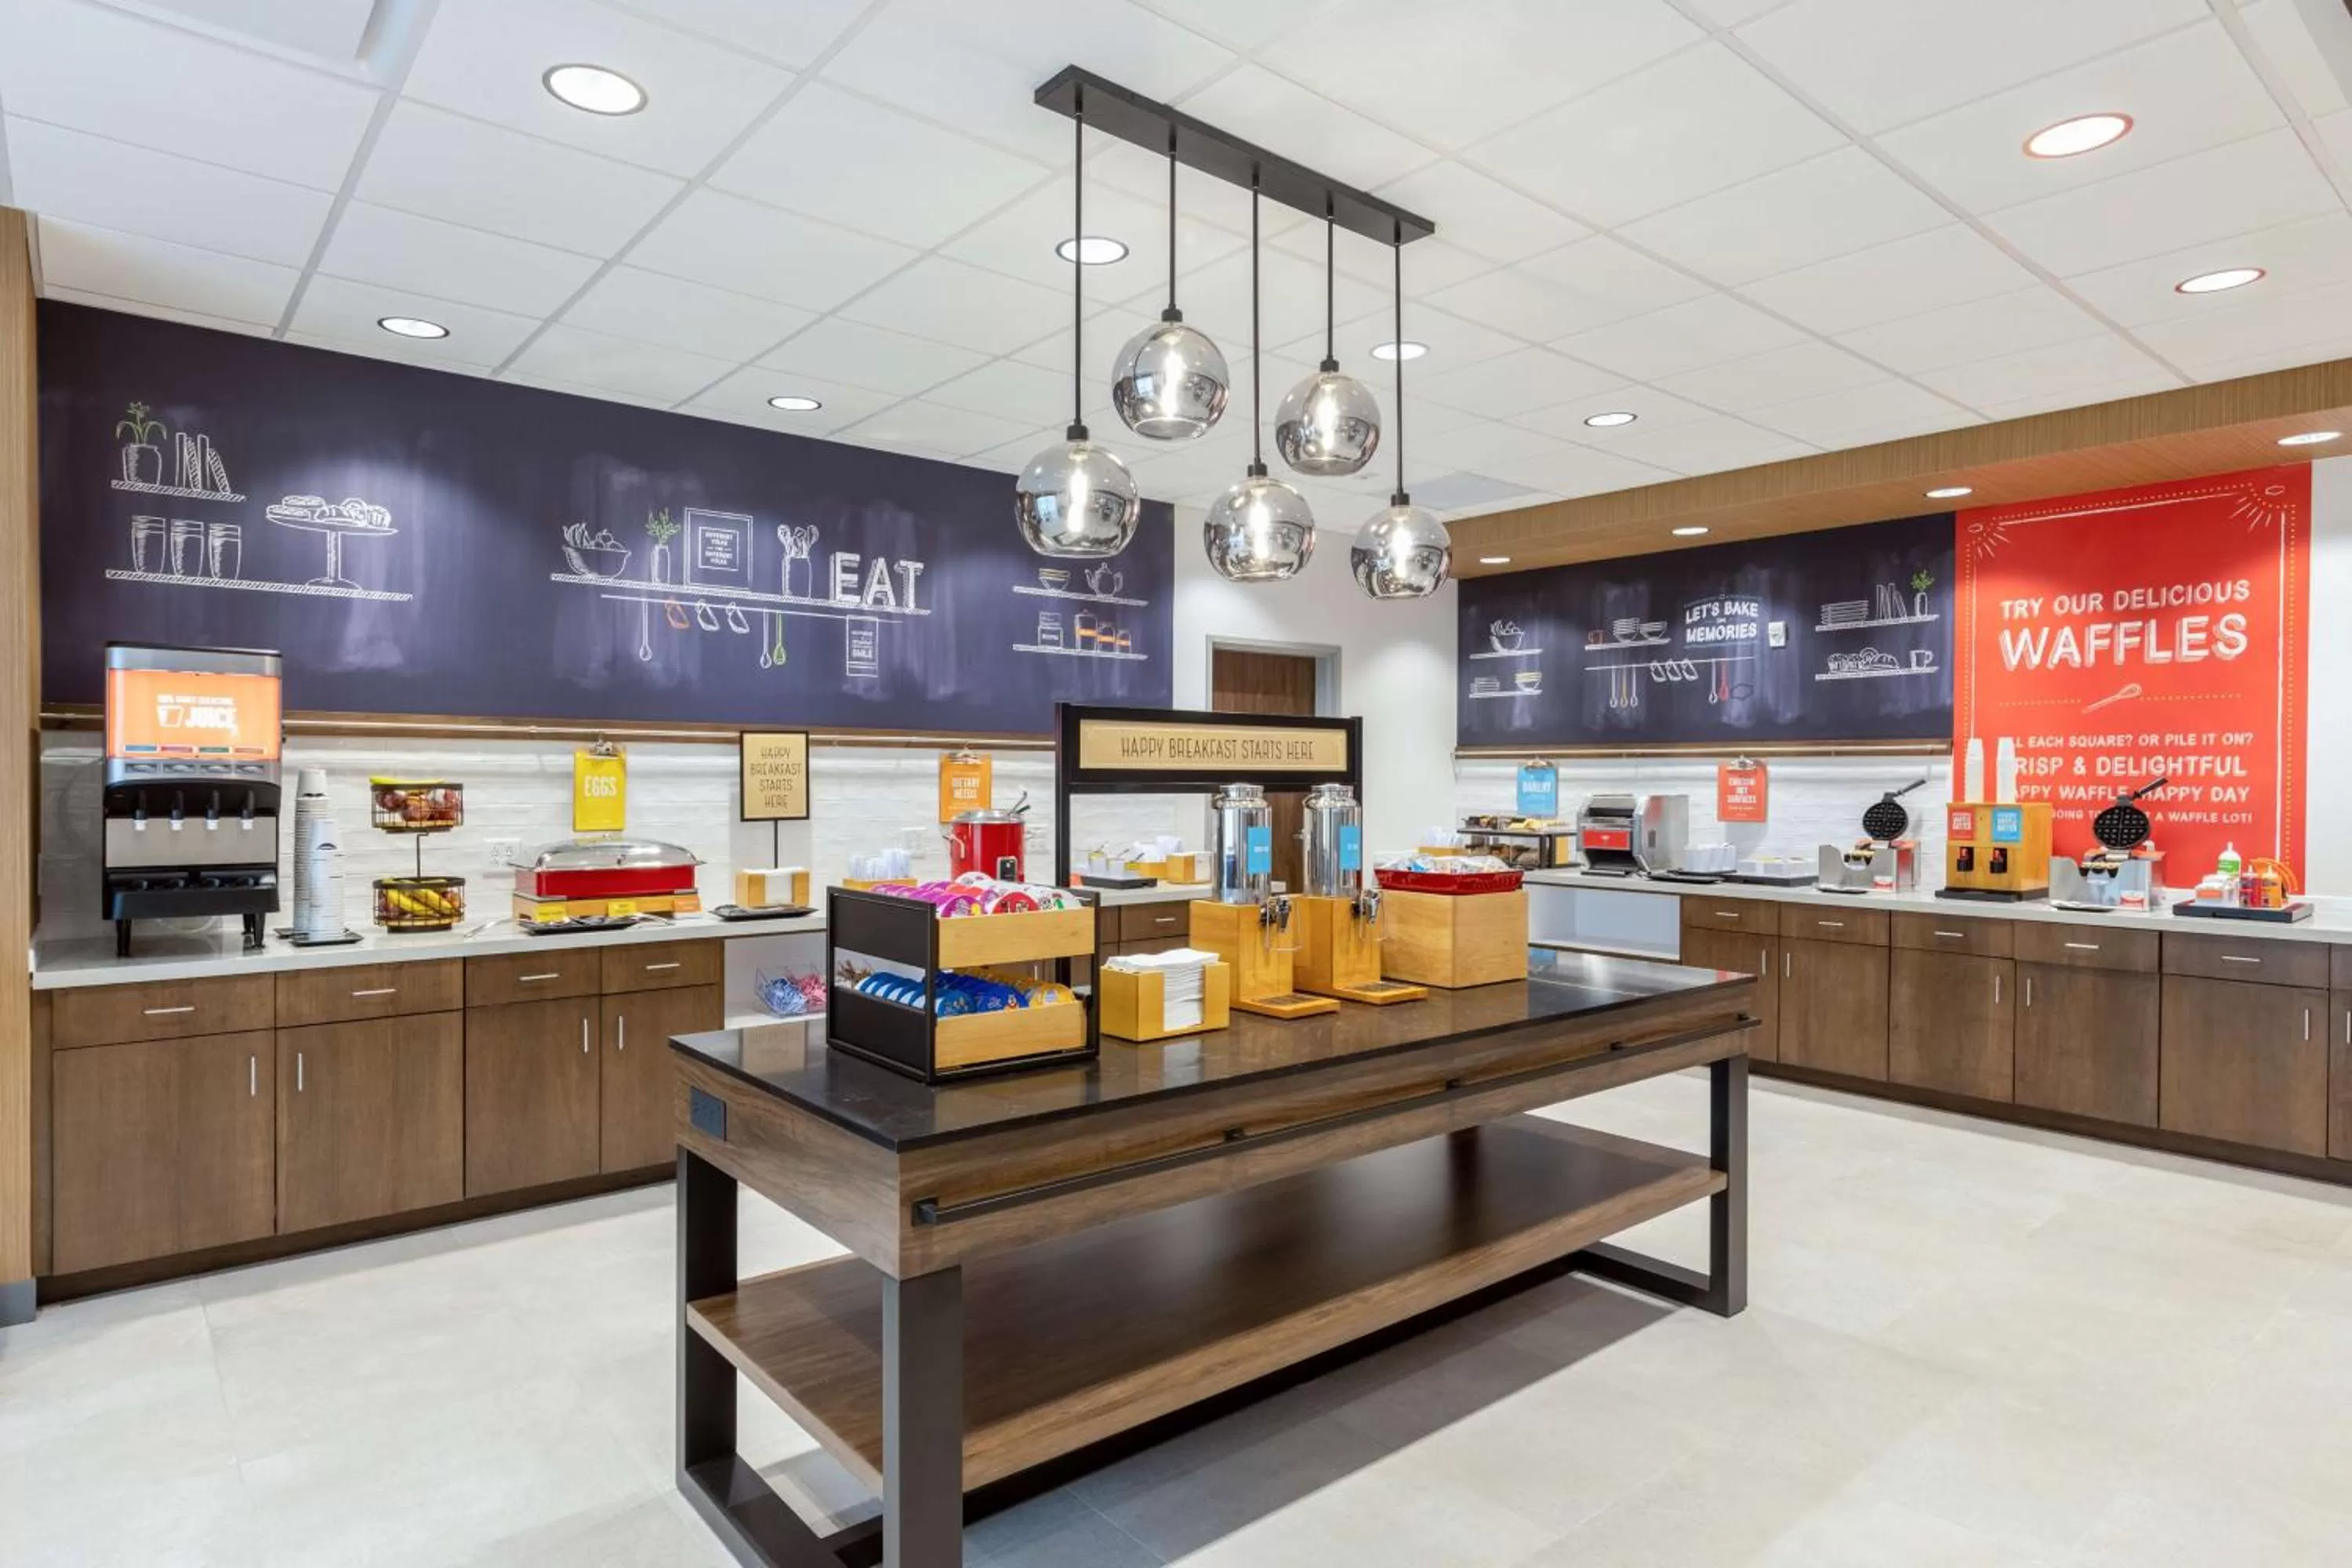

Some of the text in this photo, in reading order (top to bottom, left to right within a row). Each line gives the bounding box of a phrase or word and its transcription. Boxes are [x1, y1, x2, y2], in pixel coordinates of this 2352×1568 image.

[829, 551, 925, 609] EAT
[2000, 579, 2251, 619] TRY OUR DELICIOUS
[1685, 601, 1759, 625] LET'S BAKE
[1686, 622, 1758, 644] MEMORIES
[1998, 612, 2249, 672] WAFFLES
[1120, 736, 1315, 760] HAPPY BREAKFAST STARTS HERE
[2028, 735, 2064, 748] EACH
[2068, 733, 2133, 748] SQUARE?
[2138, 734, 2160, 746] OR
[2165, 733, 2197, 746] PILE
[2201, 733, 2217, 746] IT
[2222, 732, 2254, 746] ON?
[760, 746, 791, 760] HAPPY
[750, 761, 802, 777] BREAKFAST
[2015, 755, 2248, 777] RISP & DELIGHTFUL
[584, 775, 618, 797] EGGS
[759, 778, 793, 793] STARTS
[2209, 786, 2250, 804] DAY
[764, 793, 789, 809] HERE
[2052, 808, 2084, 820] OING
[2168, 811, 2219, 823] WAFFLE
